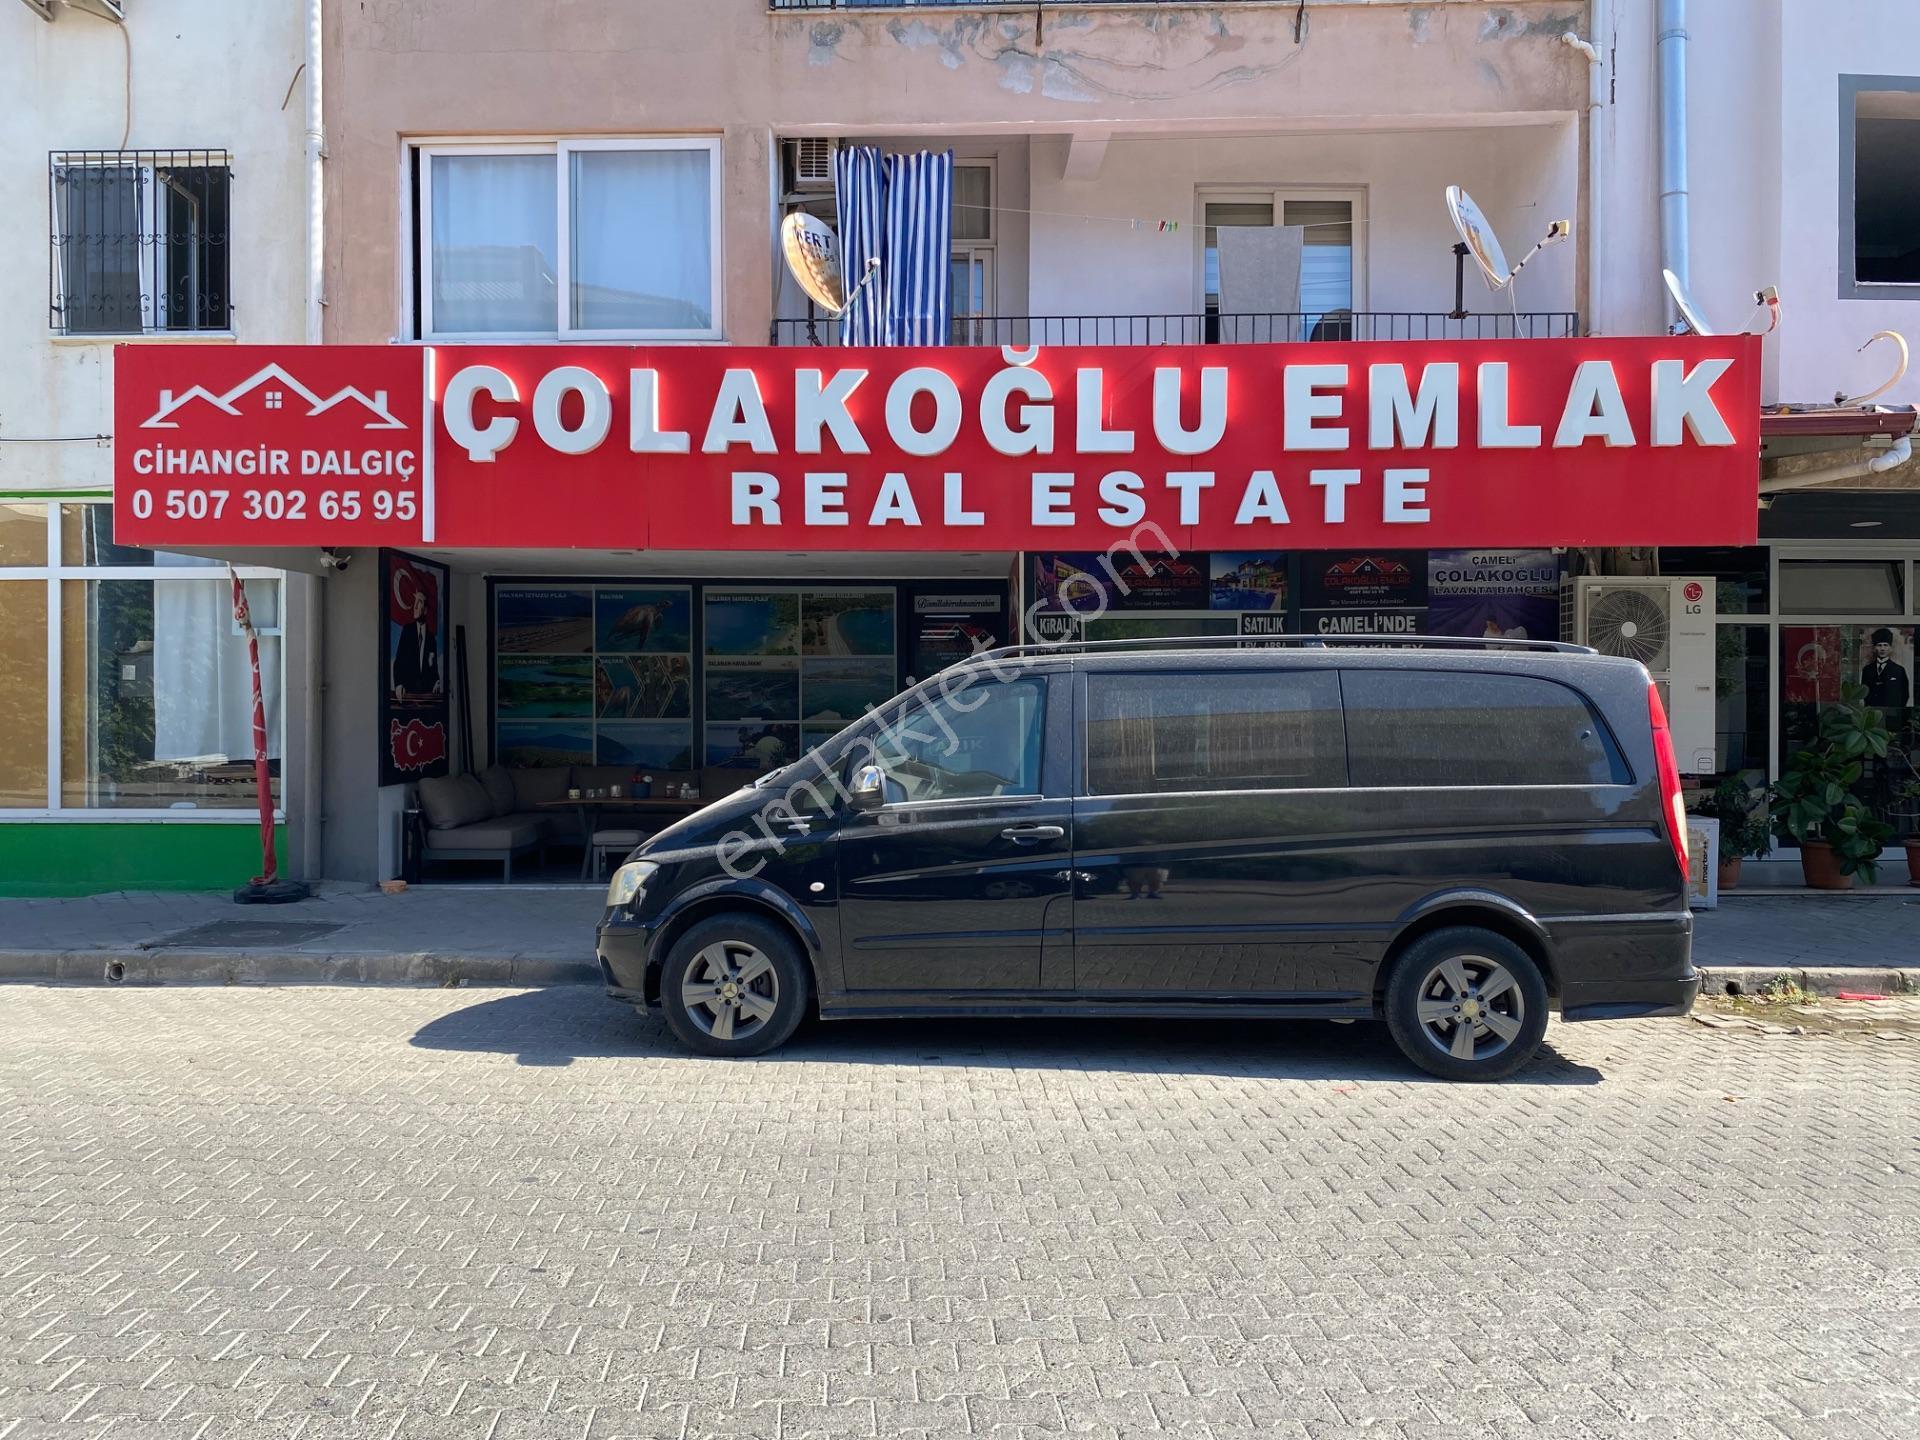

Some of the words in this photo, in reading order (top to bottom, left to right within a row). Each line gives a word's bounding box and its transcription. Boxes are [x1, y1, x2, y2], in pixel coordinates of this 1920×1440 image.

[443, 345, 1229, 463] ÇOLAKOĞLU
[1284, 358, 1738, 452] EMLAK
[132, 443, 291, 475] CİHANGİR
[301, 449, 416, 482] DALGIÇ
[132, 489, 153, 519] 0
[166, 489, 230, 520] 507
[243, 489, 307, 520] 302
[319, 489, 362, 521] 65
[373, 491, 416, 521] 95
[731, 472, 986, 527] REAL
[1031, 468, 1432, 528] ESTATE
[1244, 616, 1284, 633] SATILIK
[1686, 604, 1702, 615] LG
